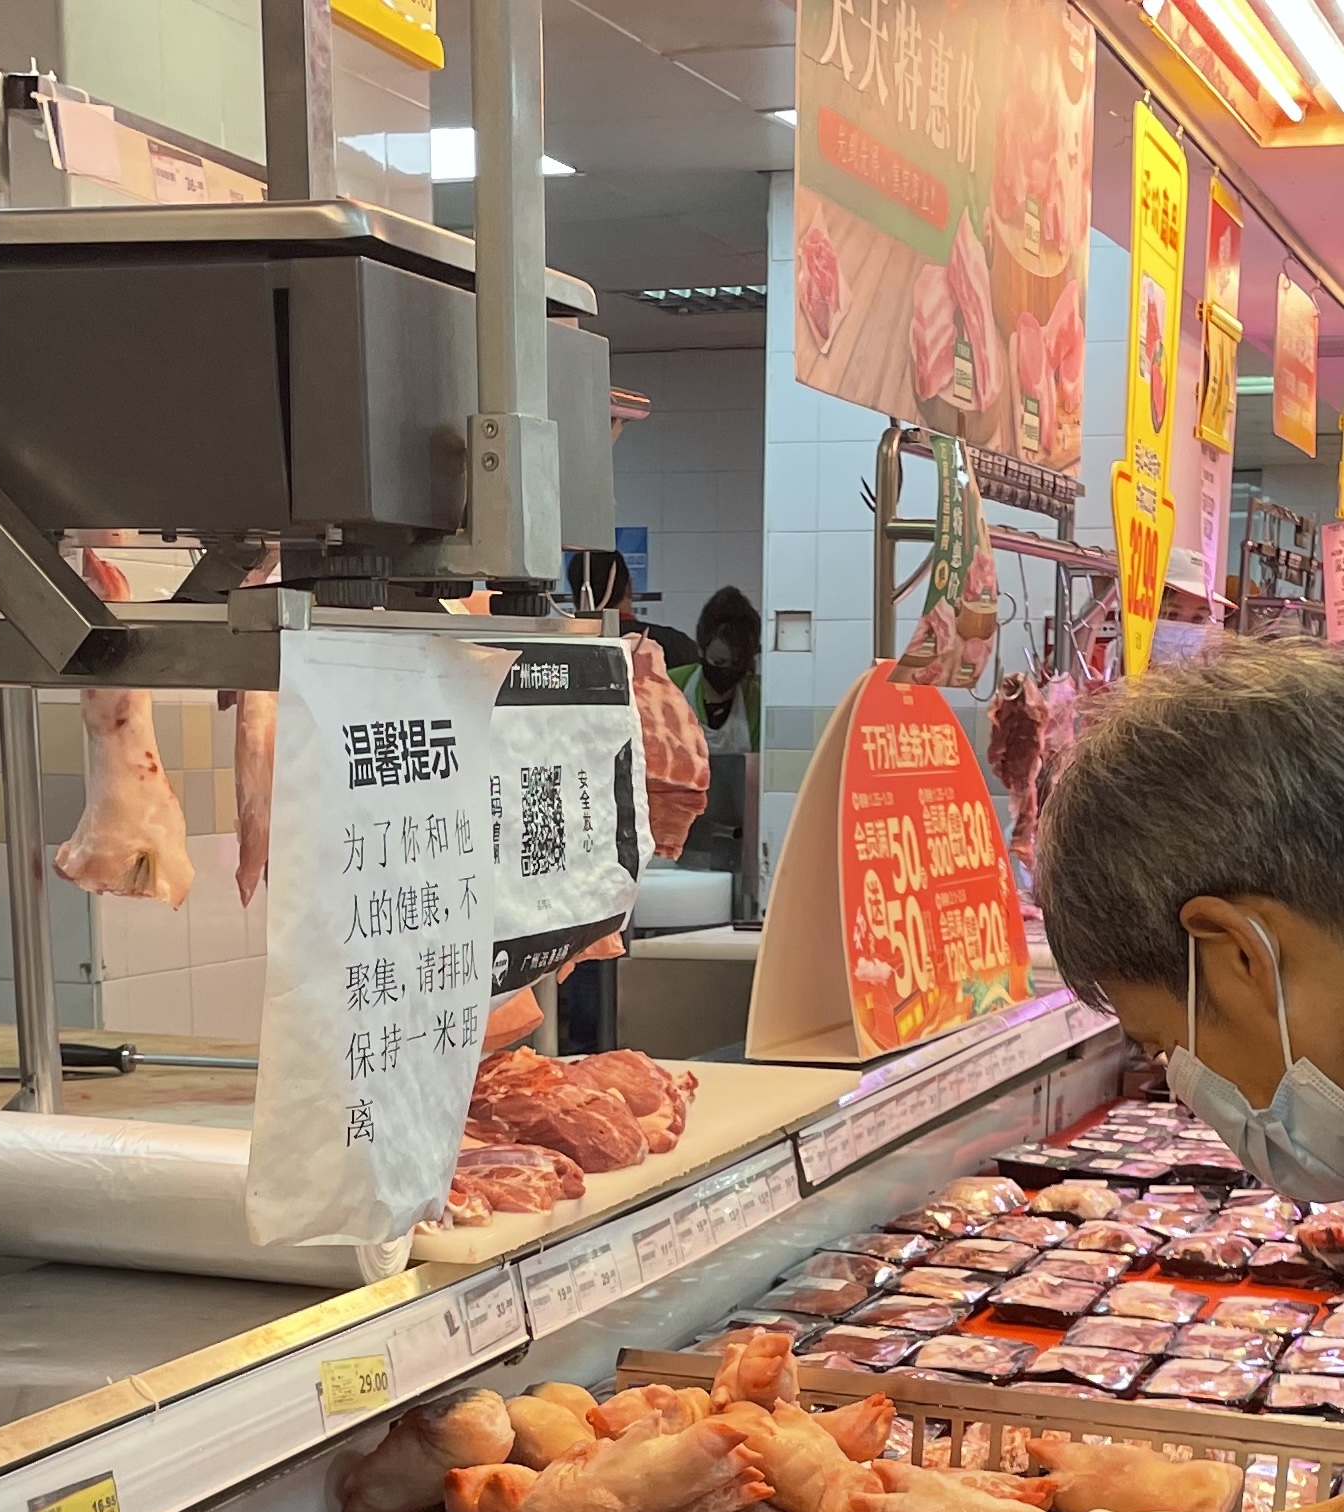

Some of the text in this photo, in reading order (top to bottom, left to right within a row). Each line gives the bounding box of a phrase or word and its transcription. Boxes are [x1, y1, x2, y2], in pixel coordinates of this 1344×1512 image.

[509, 662, 570, 690] 广州市商务局
[342, 719, 459, 790] 温馨提示
[342, 808, 474, 875] 为了你和他
[887, 815, 922, 894] 50
[885, 895, 928, 999] 50
[345, 1003, 478, 1081] 保持一米距
[345, 1098, 375, 1148] 离
[359, 1371, 389, 1395] 29.00
